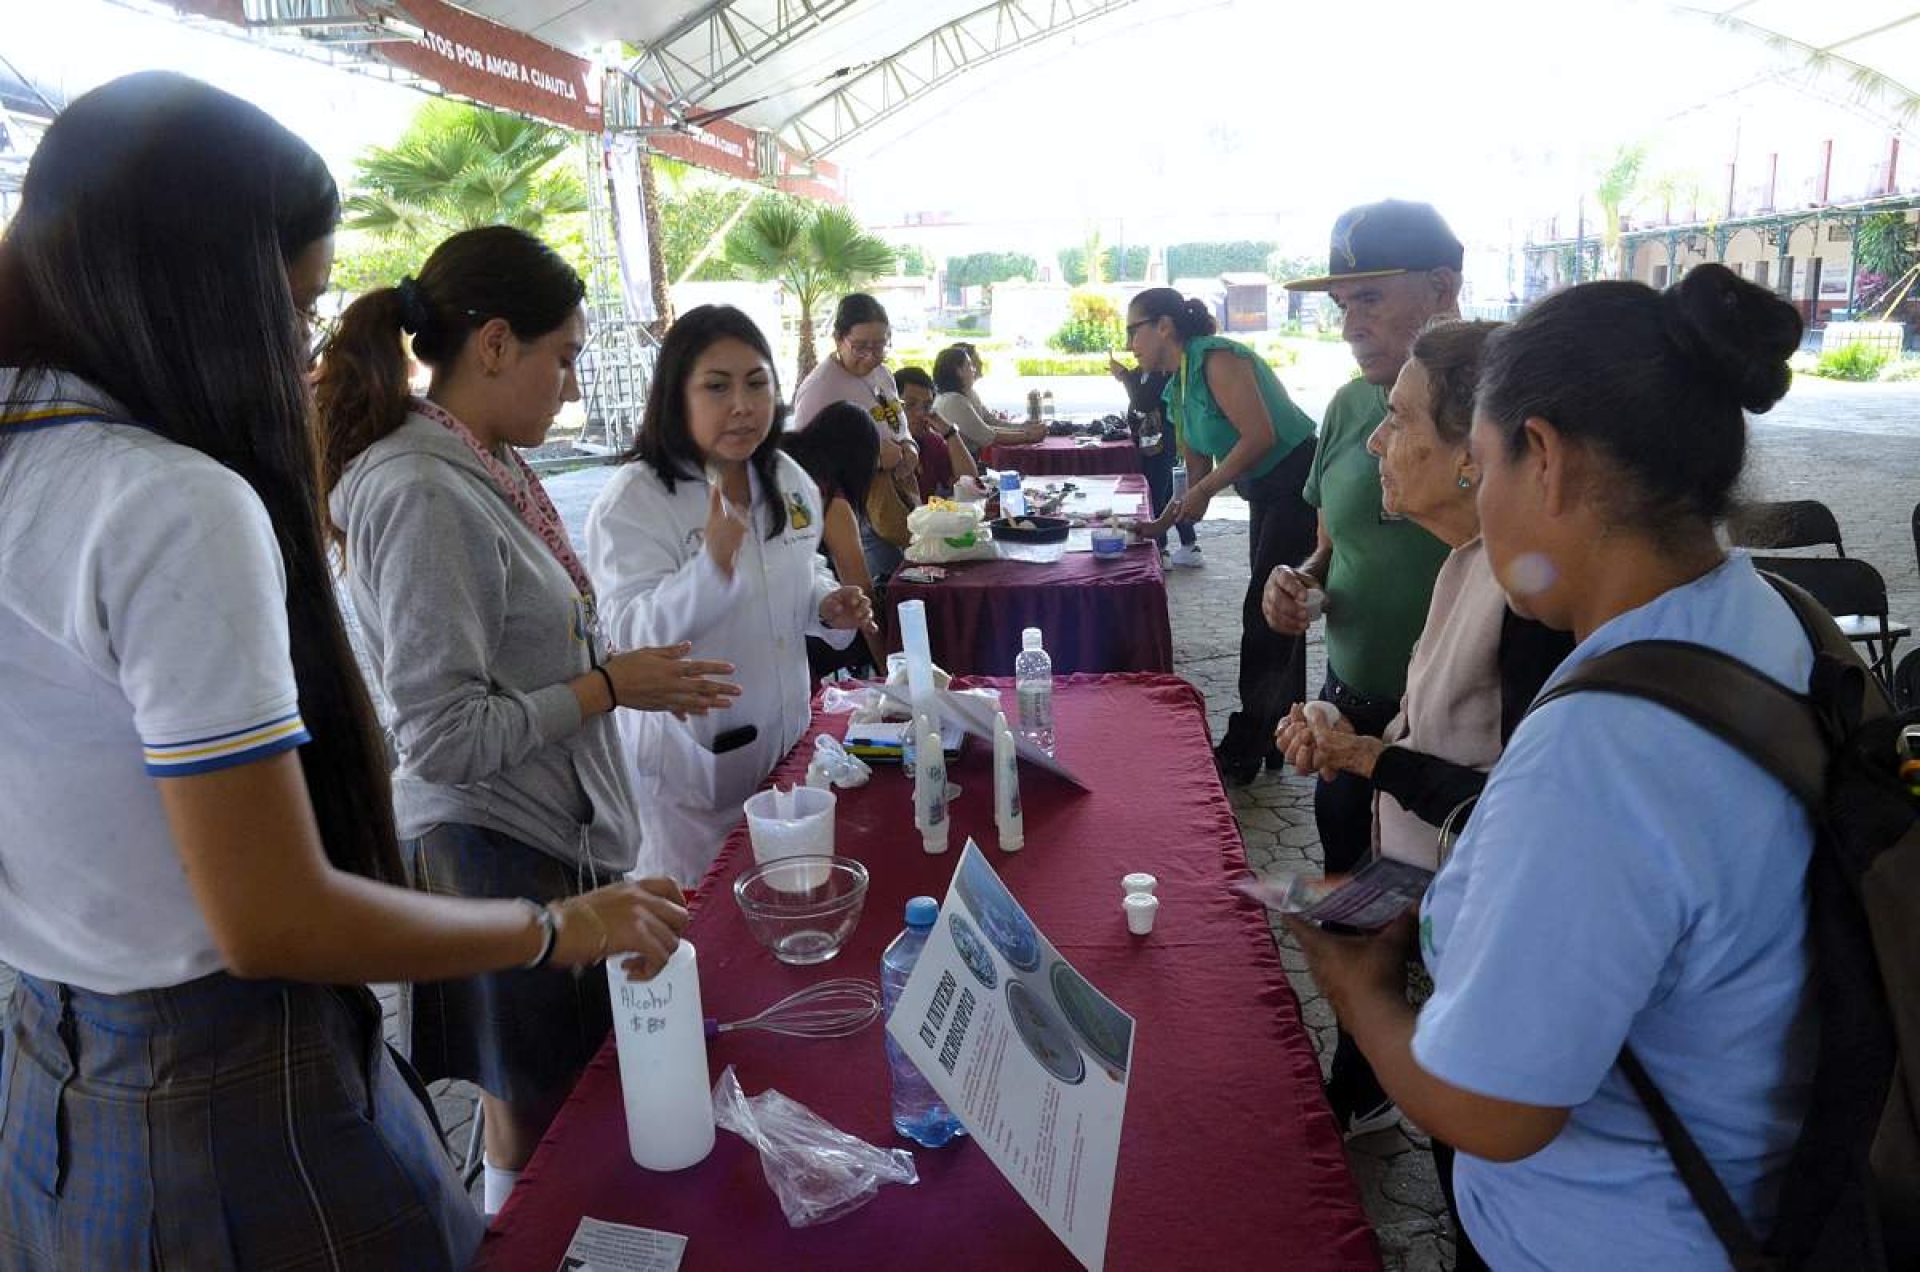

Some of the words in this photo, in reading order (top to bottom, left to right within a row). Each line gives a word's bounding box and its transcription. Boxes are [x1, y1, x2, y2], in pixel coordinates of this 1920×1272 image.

[414, 31, 455, 60] NTOS
[455, 43, 485, 70] POR
[486, 54, 519, 82] AMOR
[520, 65, 530, 83] A
[531, 68, 577, 101] CUAUTLA
